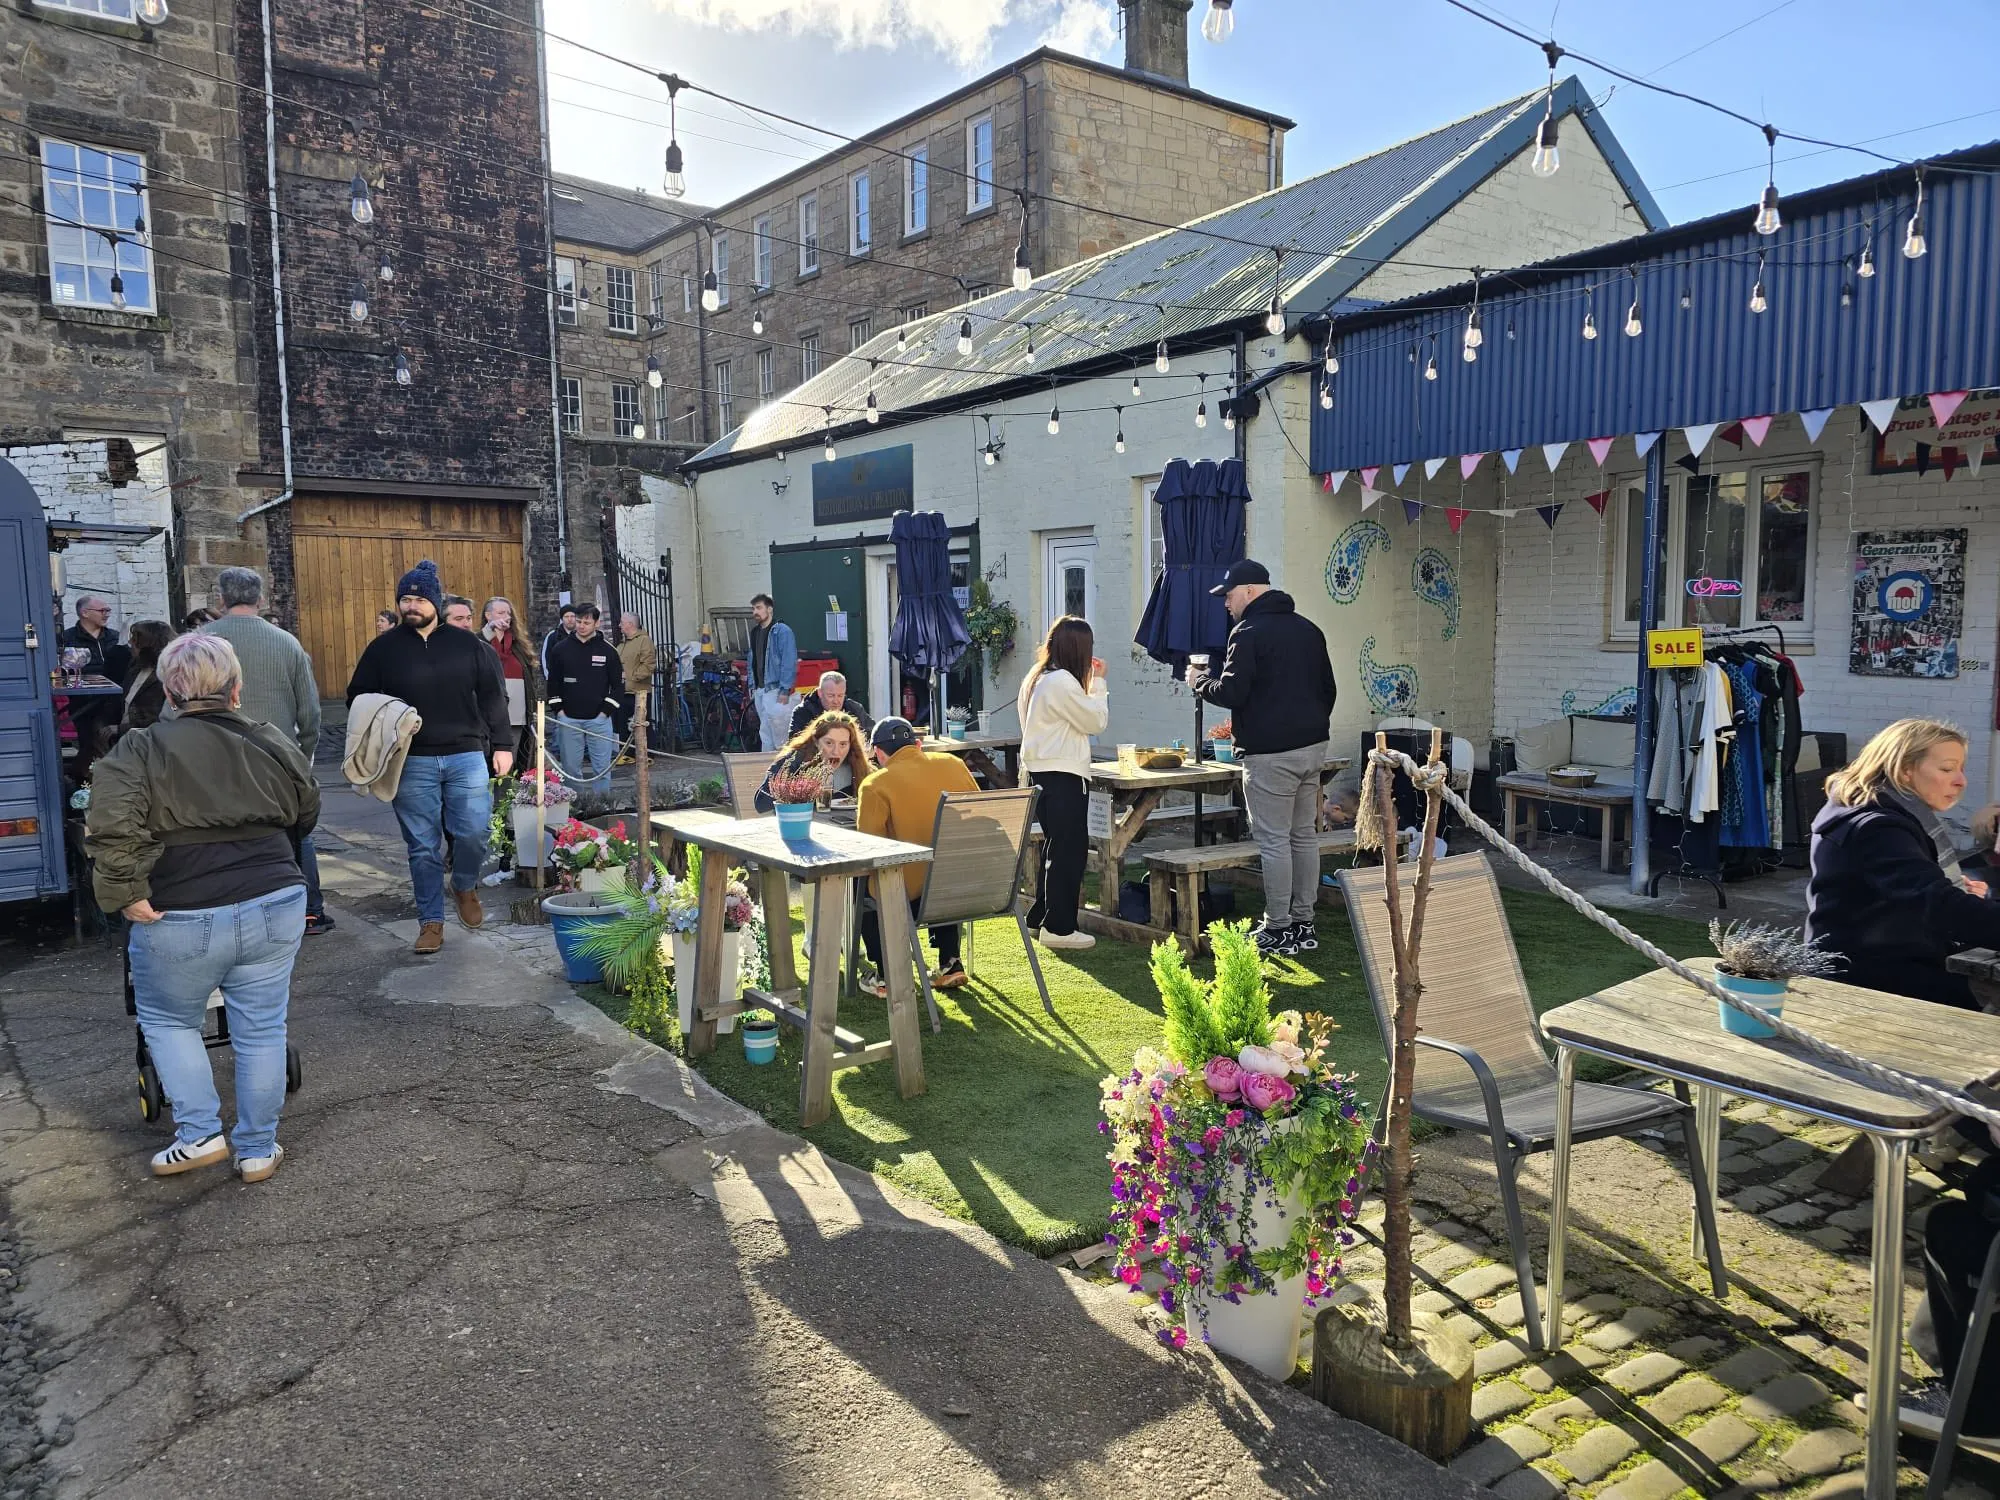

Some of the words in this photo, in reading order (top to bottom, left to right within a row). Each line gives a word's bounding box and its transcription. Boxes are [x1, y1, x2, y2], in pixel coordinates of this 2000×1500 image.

[1888, 420, 1925, 433] True
[1949, 428, 1981, 441] Retro
[1861, 543, 1938, 557] Generation
[1941, 541, 1953, 554] X
[1693, 577, 1740, 597] Open
[1654, 641, 1696, 654] SALE
